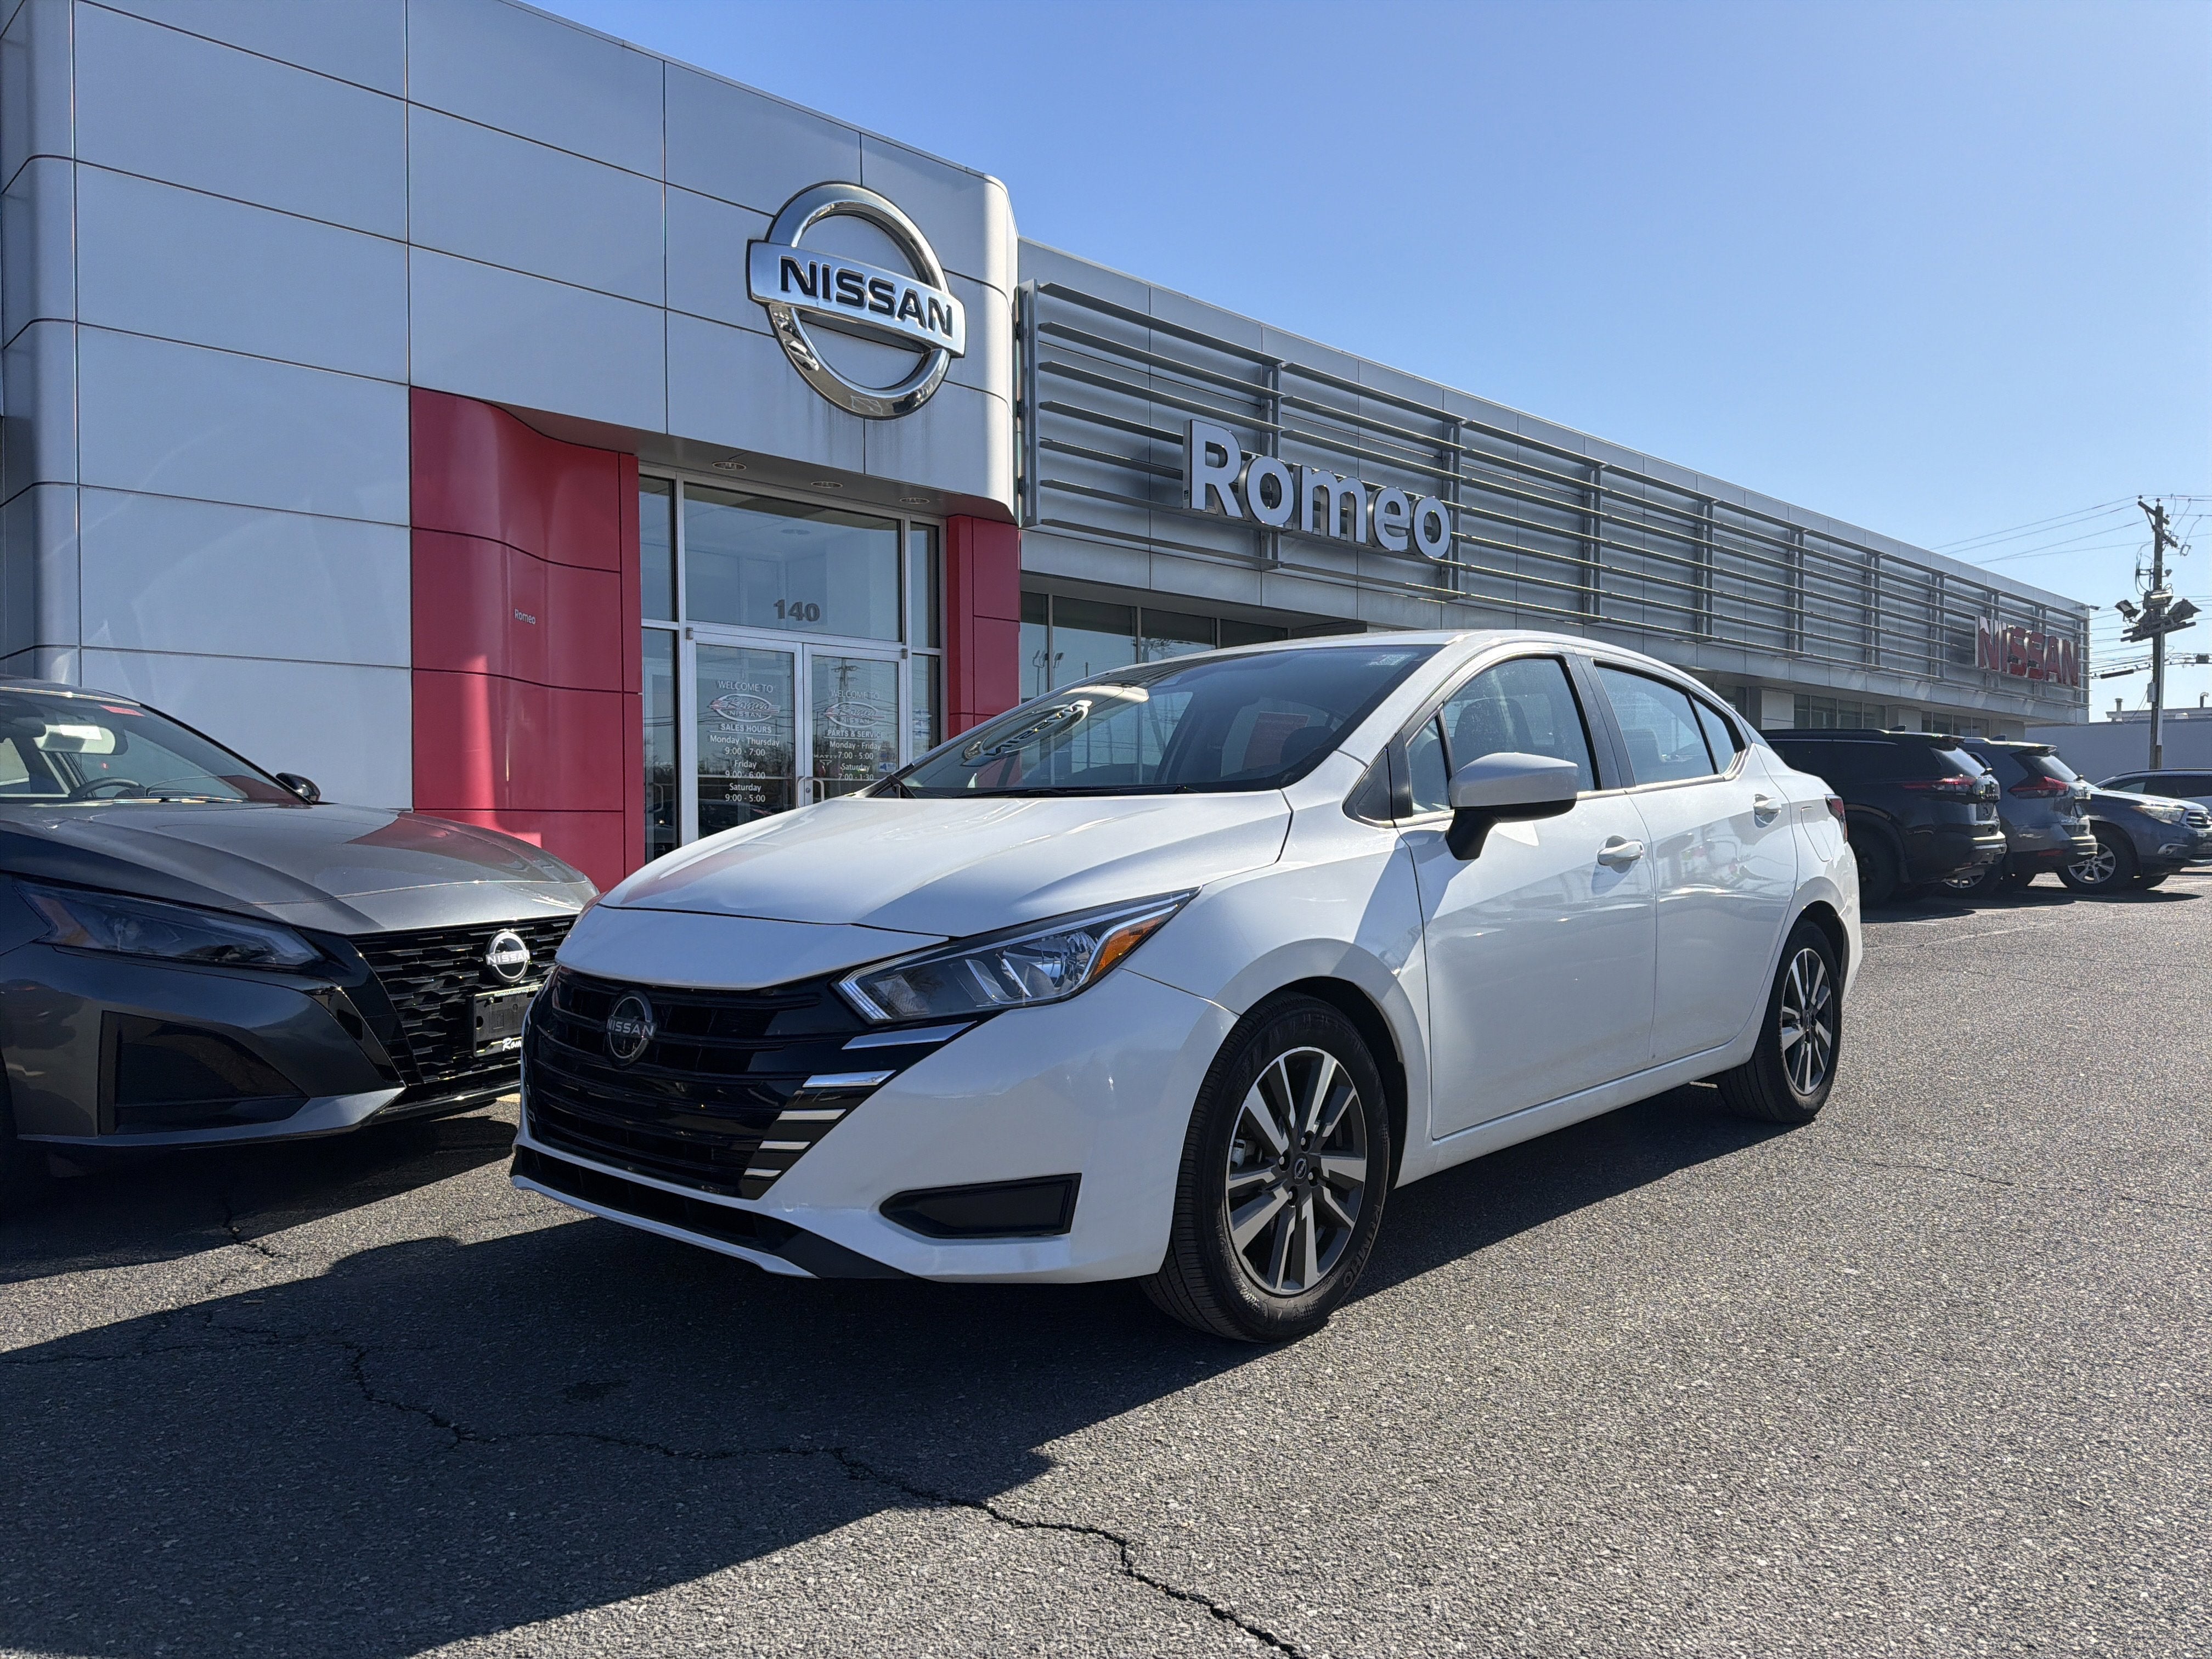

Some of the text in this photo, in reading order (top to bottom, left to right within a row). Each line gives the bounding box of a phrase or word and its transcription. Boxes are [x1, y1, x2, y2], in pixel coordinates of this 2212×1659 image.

[780, 256, 953, 341] NISSAN
[1183, 419, 1452, 558] Romeo
[515, 608, 535, 624] Romeo
[774, 599, 820, 622] 140
[1975, 616, 2080, 686] NISSAN
[718, 680, 774, 693] WELCOME TO
[831, 690, 867, 698] WELCOME
[726, 696, 770, 710] Romeo
[721, 723, 772, 733] SALES HOURS
[710, 735, 740, 745] Monday
[746, 737, 780, 748] Thursday
[830, 741, 856, 750] Monday
[862, 742, 881, 751] Friday
[725, 747, 742, 755] 9:00
[735, 759, 757, 769] Friday
[842, 763, 870, 772] Saturday
[725, 770, 742, 778] 9:00
[729, 783, 761, 792] Saturday
[725, 794, 742, 802] 9:00
[749, 794, 765, 803] 5:00
[487, 952, 530, 963] NISSAN
[606, 1019, 654, 1036] NISSAN
